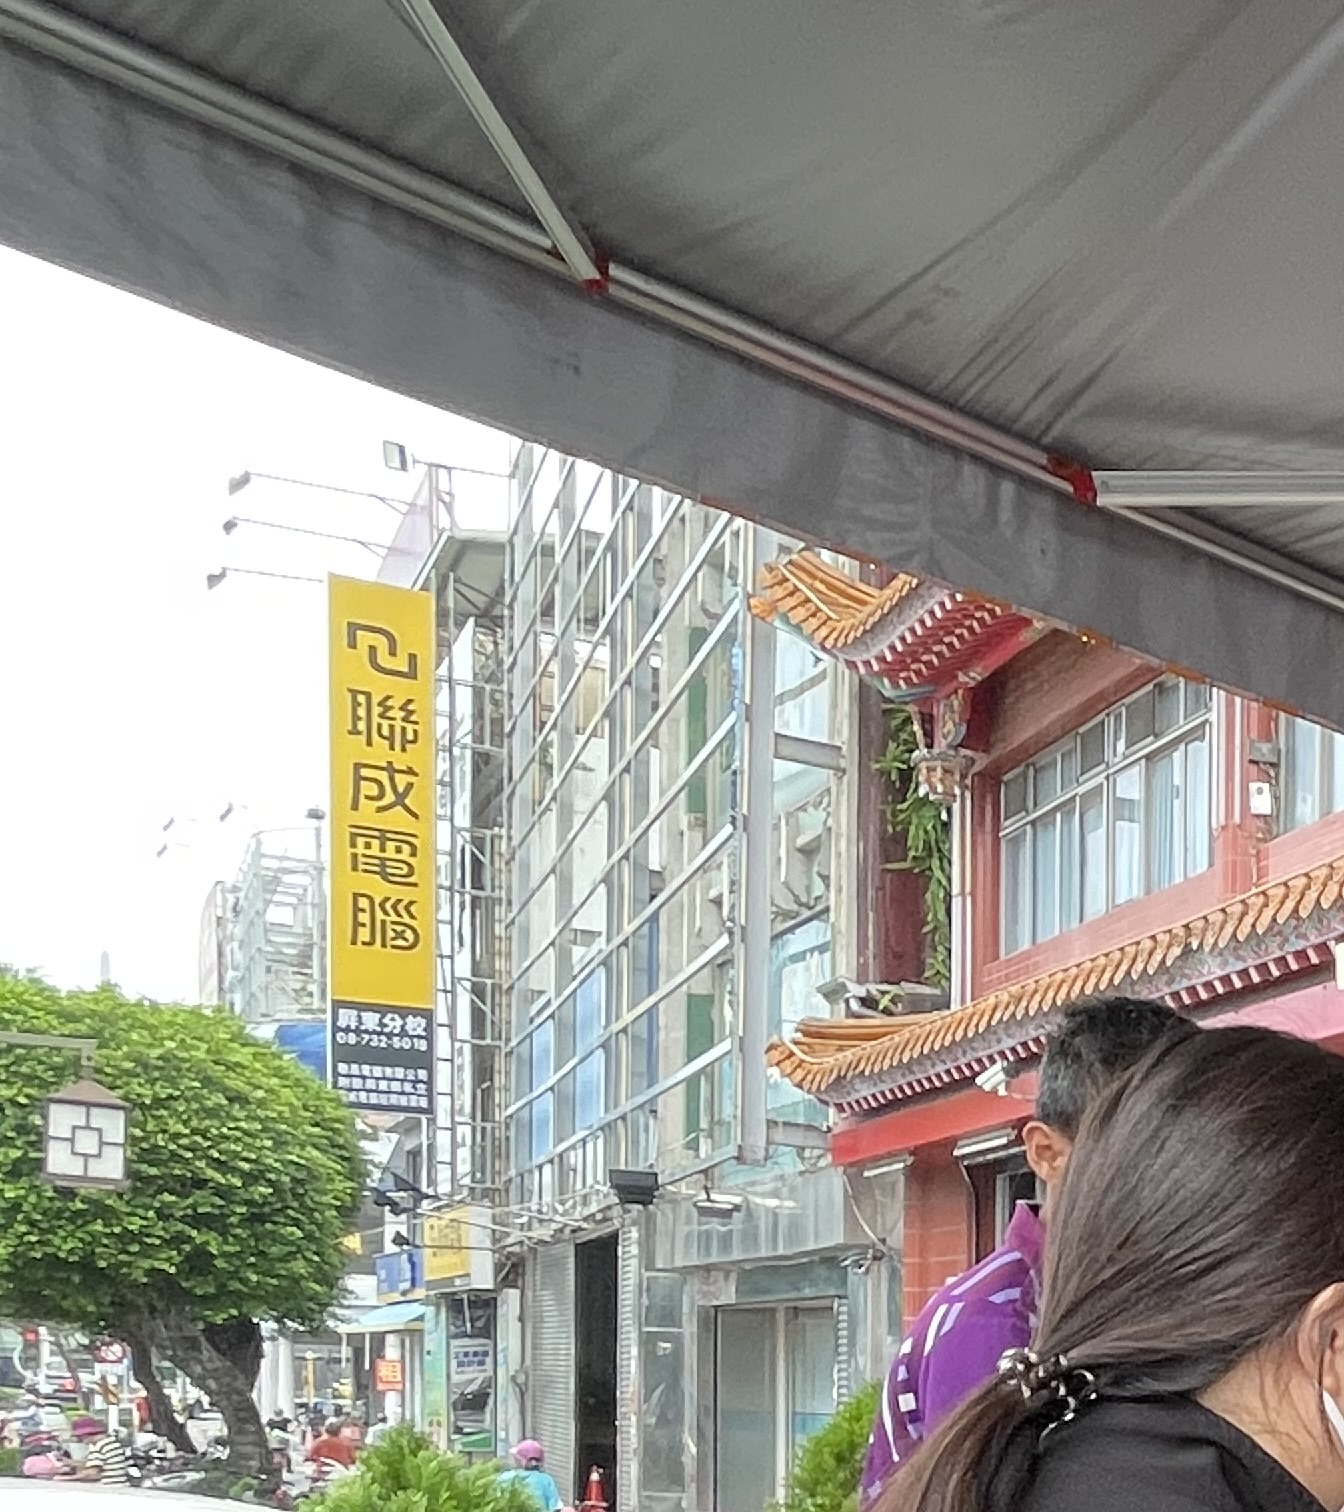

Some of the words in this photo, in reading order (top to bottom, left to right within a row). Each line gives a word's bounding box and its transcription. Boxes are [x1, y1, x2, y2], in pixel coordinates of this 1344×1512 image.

[346, 688, 420, 952] 聯成電腦
[336, 1008, 428, 1036] 屏東分校
